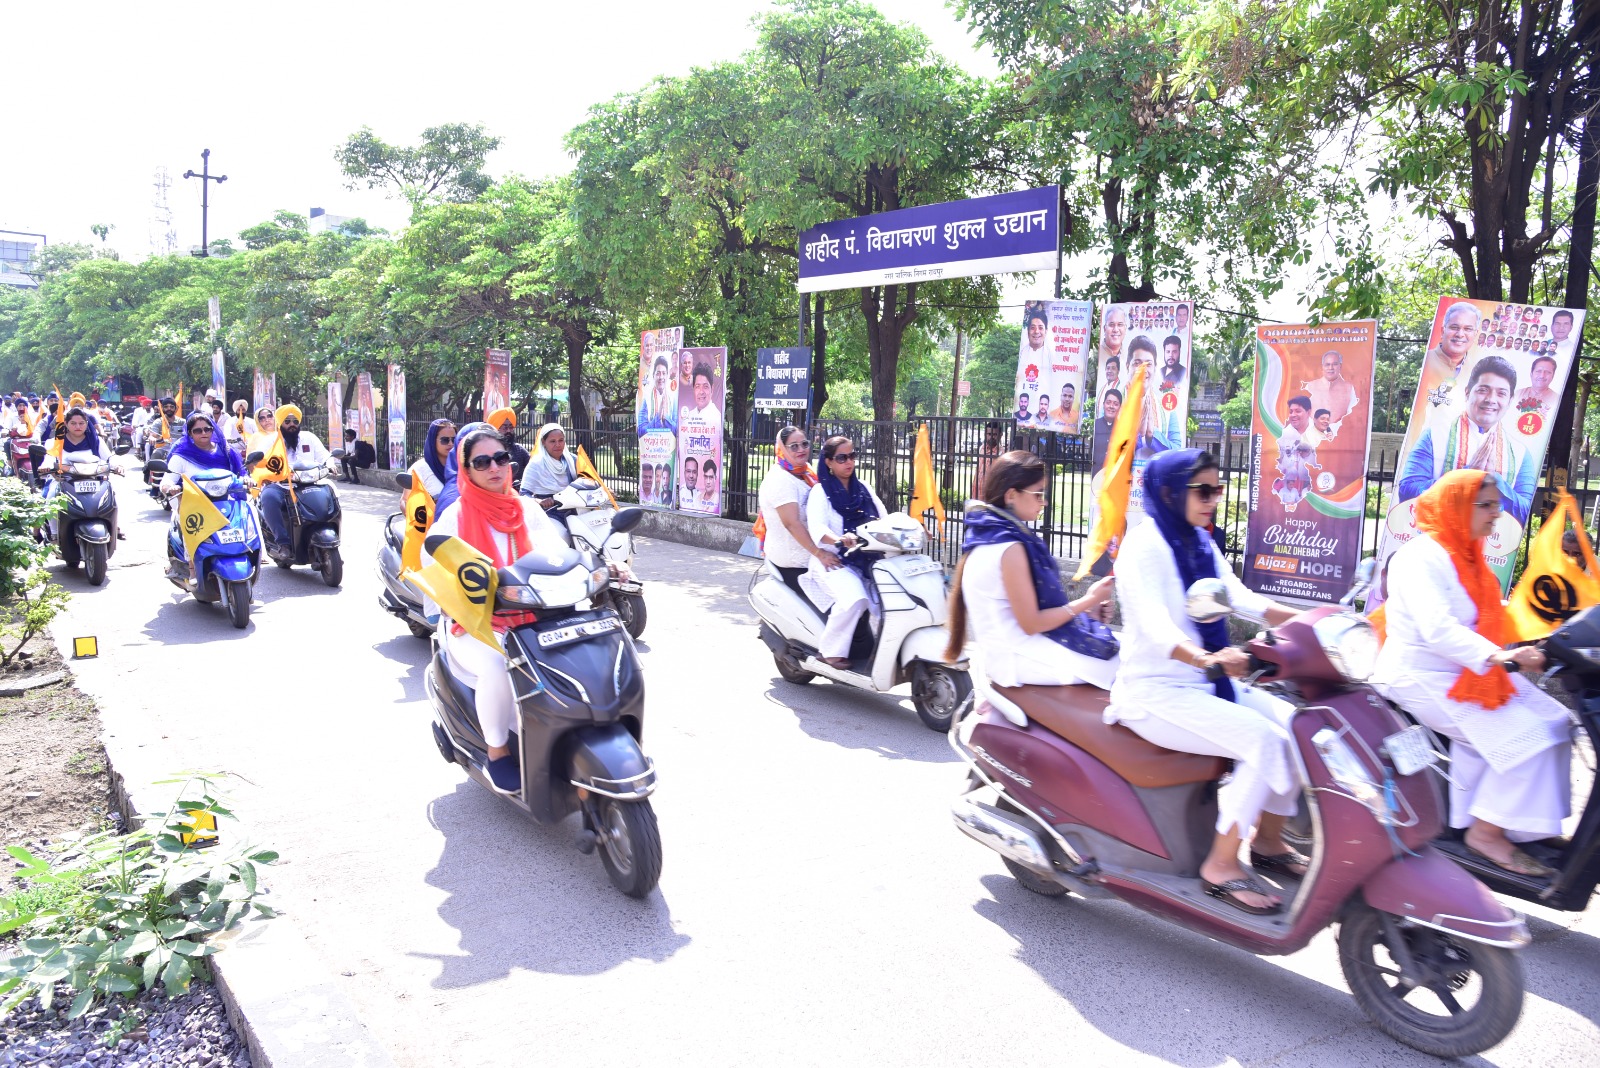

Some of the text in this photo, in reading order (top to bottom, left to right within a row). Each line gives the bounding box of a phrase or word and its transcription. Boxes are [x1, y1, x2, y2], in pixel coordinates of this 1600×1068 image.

[804, 209, 1048, 262] शहीद पं. विद्याचरण शुक्ल उद्यान
[774, 350, 789, 364] शहीद
[766, 366, 791, 379] विद्याचरण
[792, 368, 807, 383] शुक्ल
[1165, 402, 1173, 410] मई
[1526, 415, 1533, 425] 1
[1522, 424, 1536, 434] मई
[1251, 433, 1263, 511] #HBDAijazDhebar
[1285, 518, 1318, 530] Happy
[1263, 524, 1339, 557] Birthday
[1273, 545, 1320, 558] AIJAZ DHEBAR
[1257, 556, 1296, 570] Aijaz is
[1300, 561, 1343, 578] HOPE
[1260, 584, 1332, 600] AIJAZ DHEBAR FANS
[542, 633, 553, 643] CG
